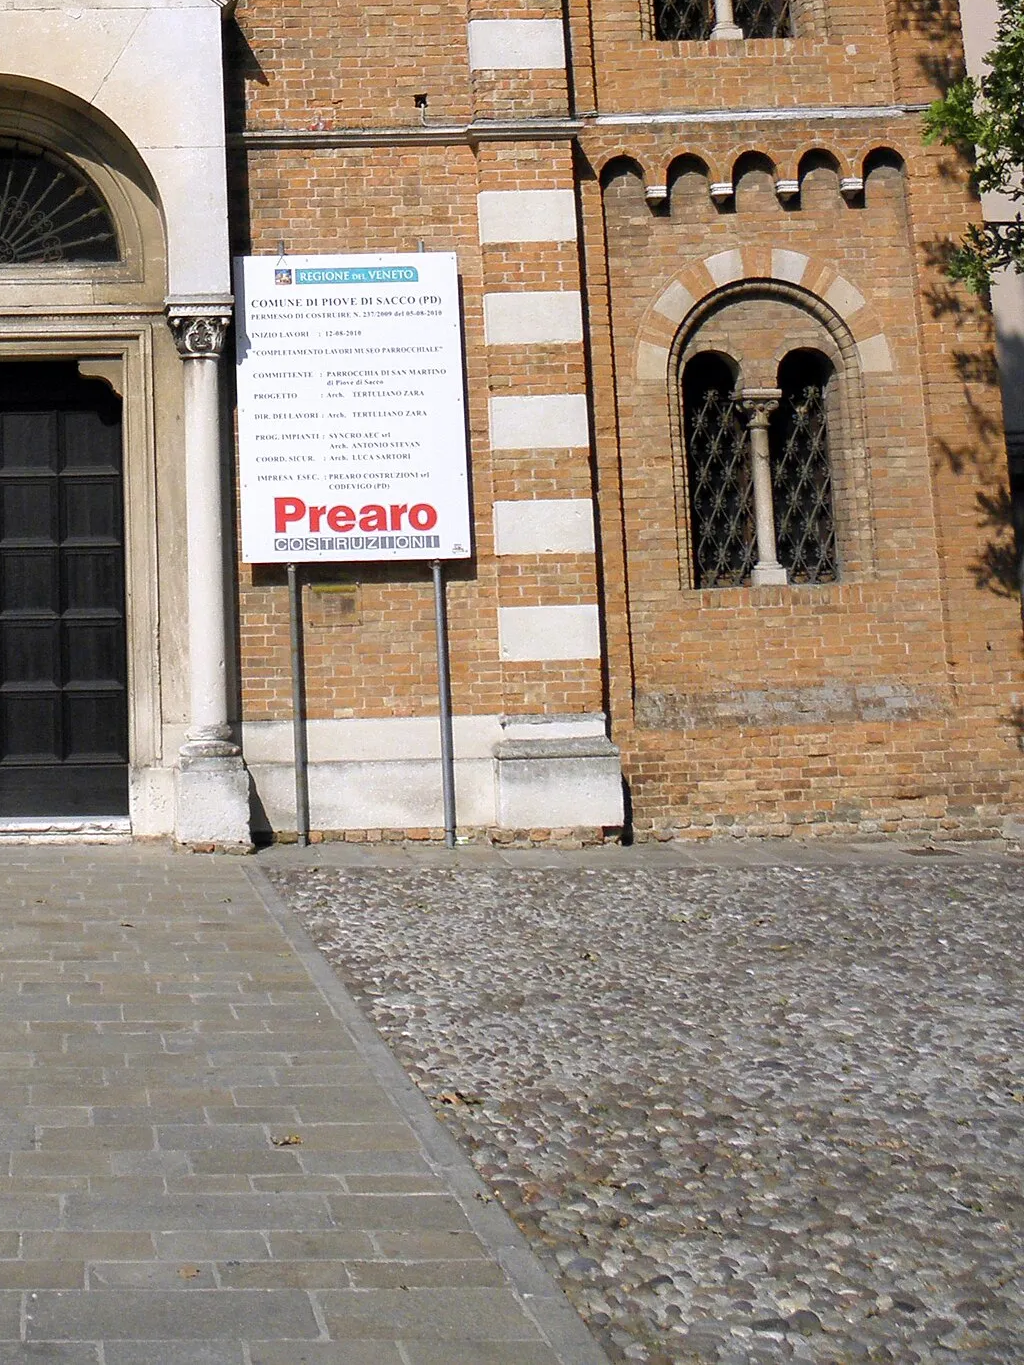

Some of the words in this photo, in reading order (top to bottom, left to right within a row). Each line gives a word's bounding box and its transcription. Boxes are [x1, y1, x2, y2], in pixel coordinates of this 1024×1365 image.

[300, 272, 350, 281] REGIONE
[368, 270, 413, 280] VENETO
[251, 299, 302, 308] COMUNE
[306, 298, 317, 307] DI
[322, 298, 357, 306] PIOVE
[361, 297, 372, 305] DI
[376, 296, 415, 305] SACCO
[419, 295, 441, 305] (PD)
[382, 346, 443, 354] PARROCCHIALE"
[275, 497, 437, 533] Prearo
[275, 535, 440, 551] COSTRUZIONI
